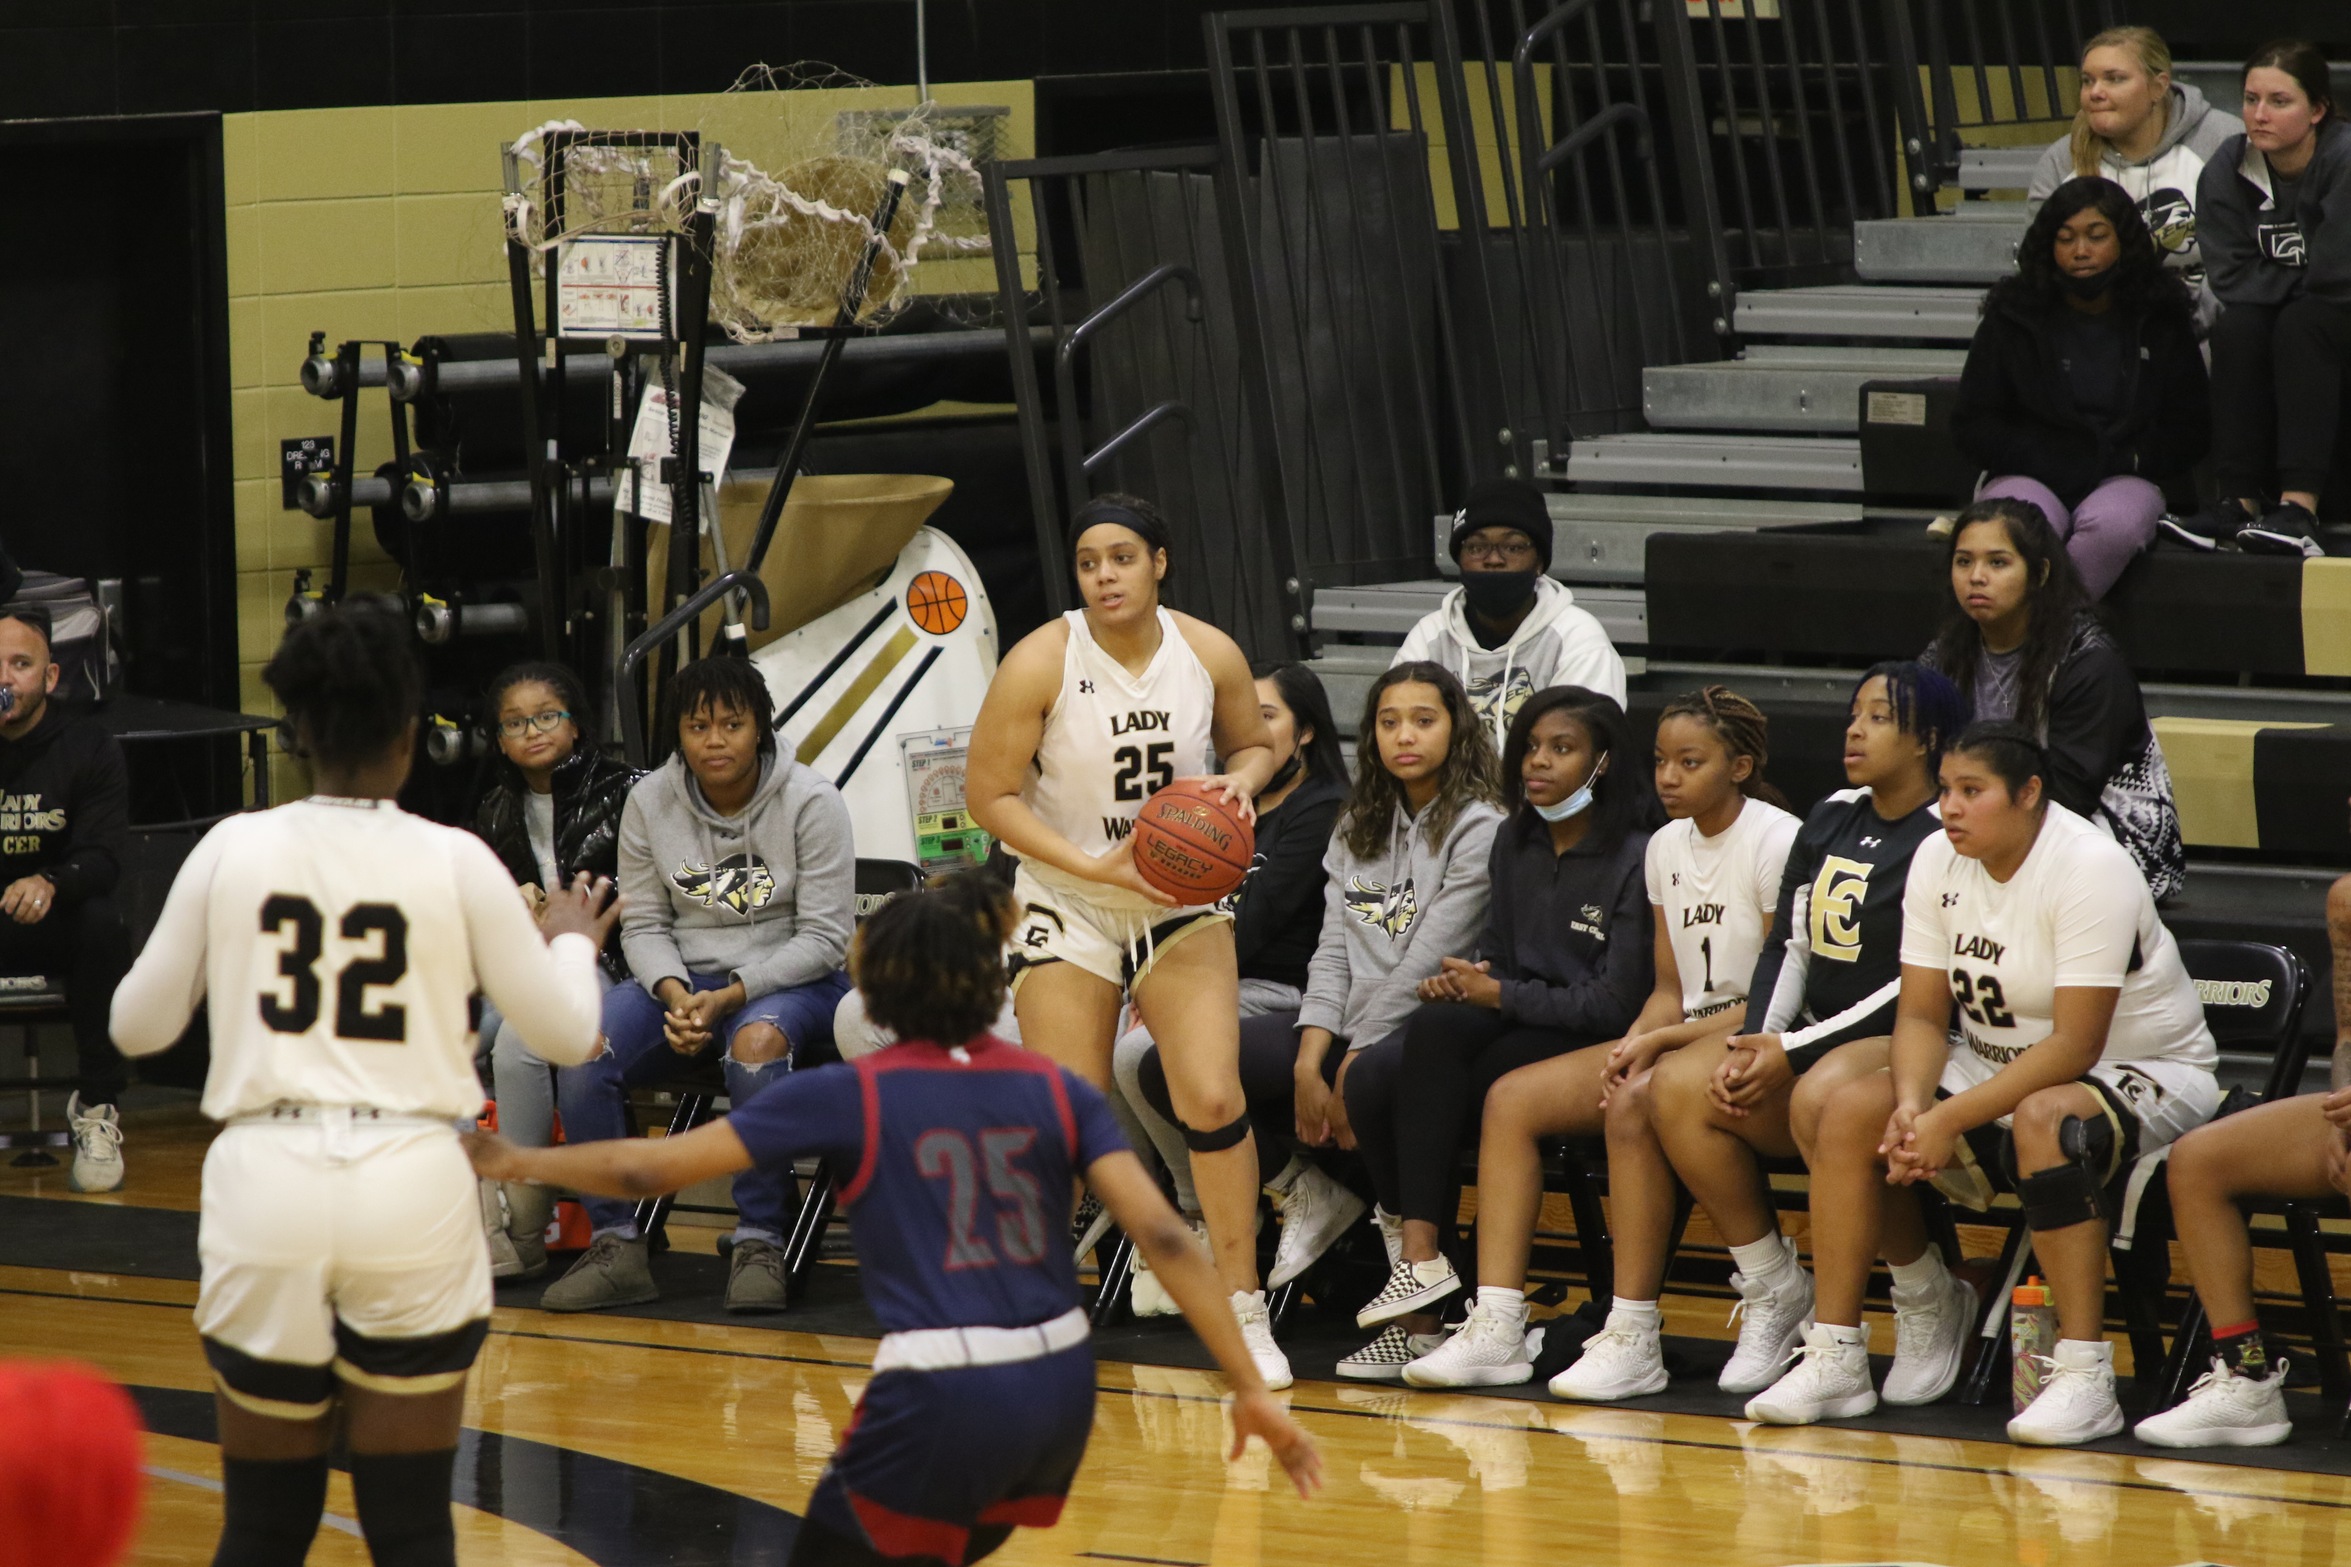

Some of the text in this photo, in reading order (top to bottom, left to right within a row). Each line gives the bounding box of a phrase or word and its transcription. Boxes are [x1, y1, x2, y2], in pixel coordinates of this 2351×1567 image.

[301, 439, 316, 450] 123
[1109, 710, 1173, 737] LADY
[911, 758, 932, 769] STEP 1
[1113, 741, 1176, 803] 25
[918, 815, 933, 825] STEP
[1156, 801, 1233, 853] SPALDING
[2, 834, 42, 855] CER
[1146, 832, 1214, 876] LEGACY
[1682, 903, 1727, 929] LADY
[1810, 854, 1876, 963] EC
[257, 891, 409, 1043] 32
[1700, 936, 1715, 992] 1
[1953, 932, 2007, 966] LADY
[1952, 967, 2018, 1029] 22
[2192, 978, 2274, 1008] RRIORS
[913, 1126, 1047, 1273] 25
